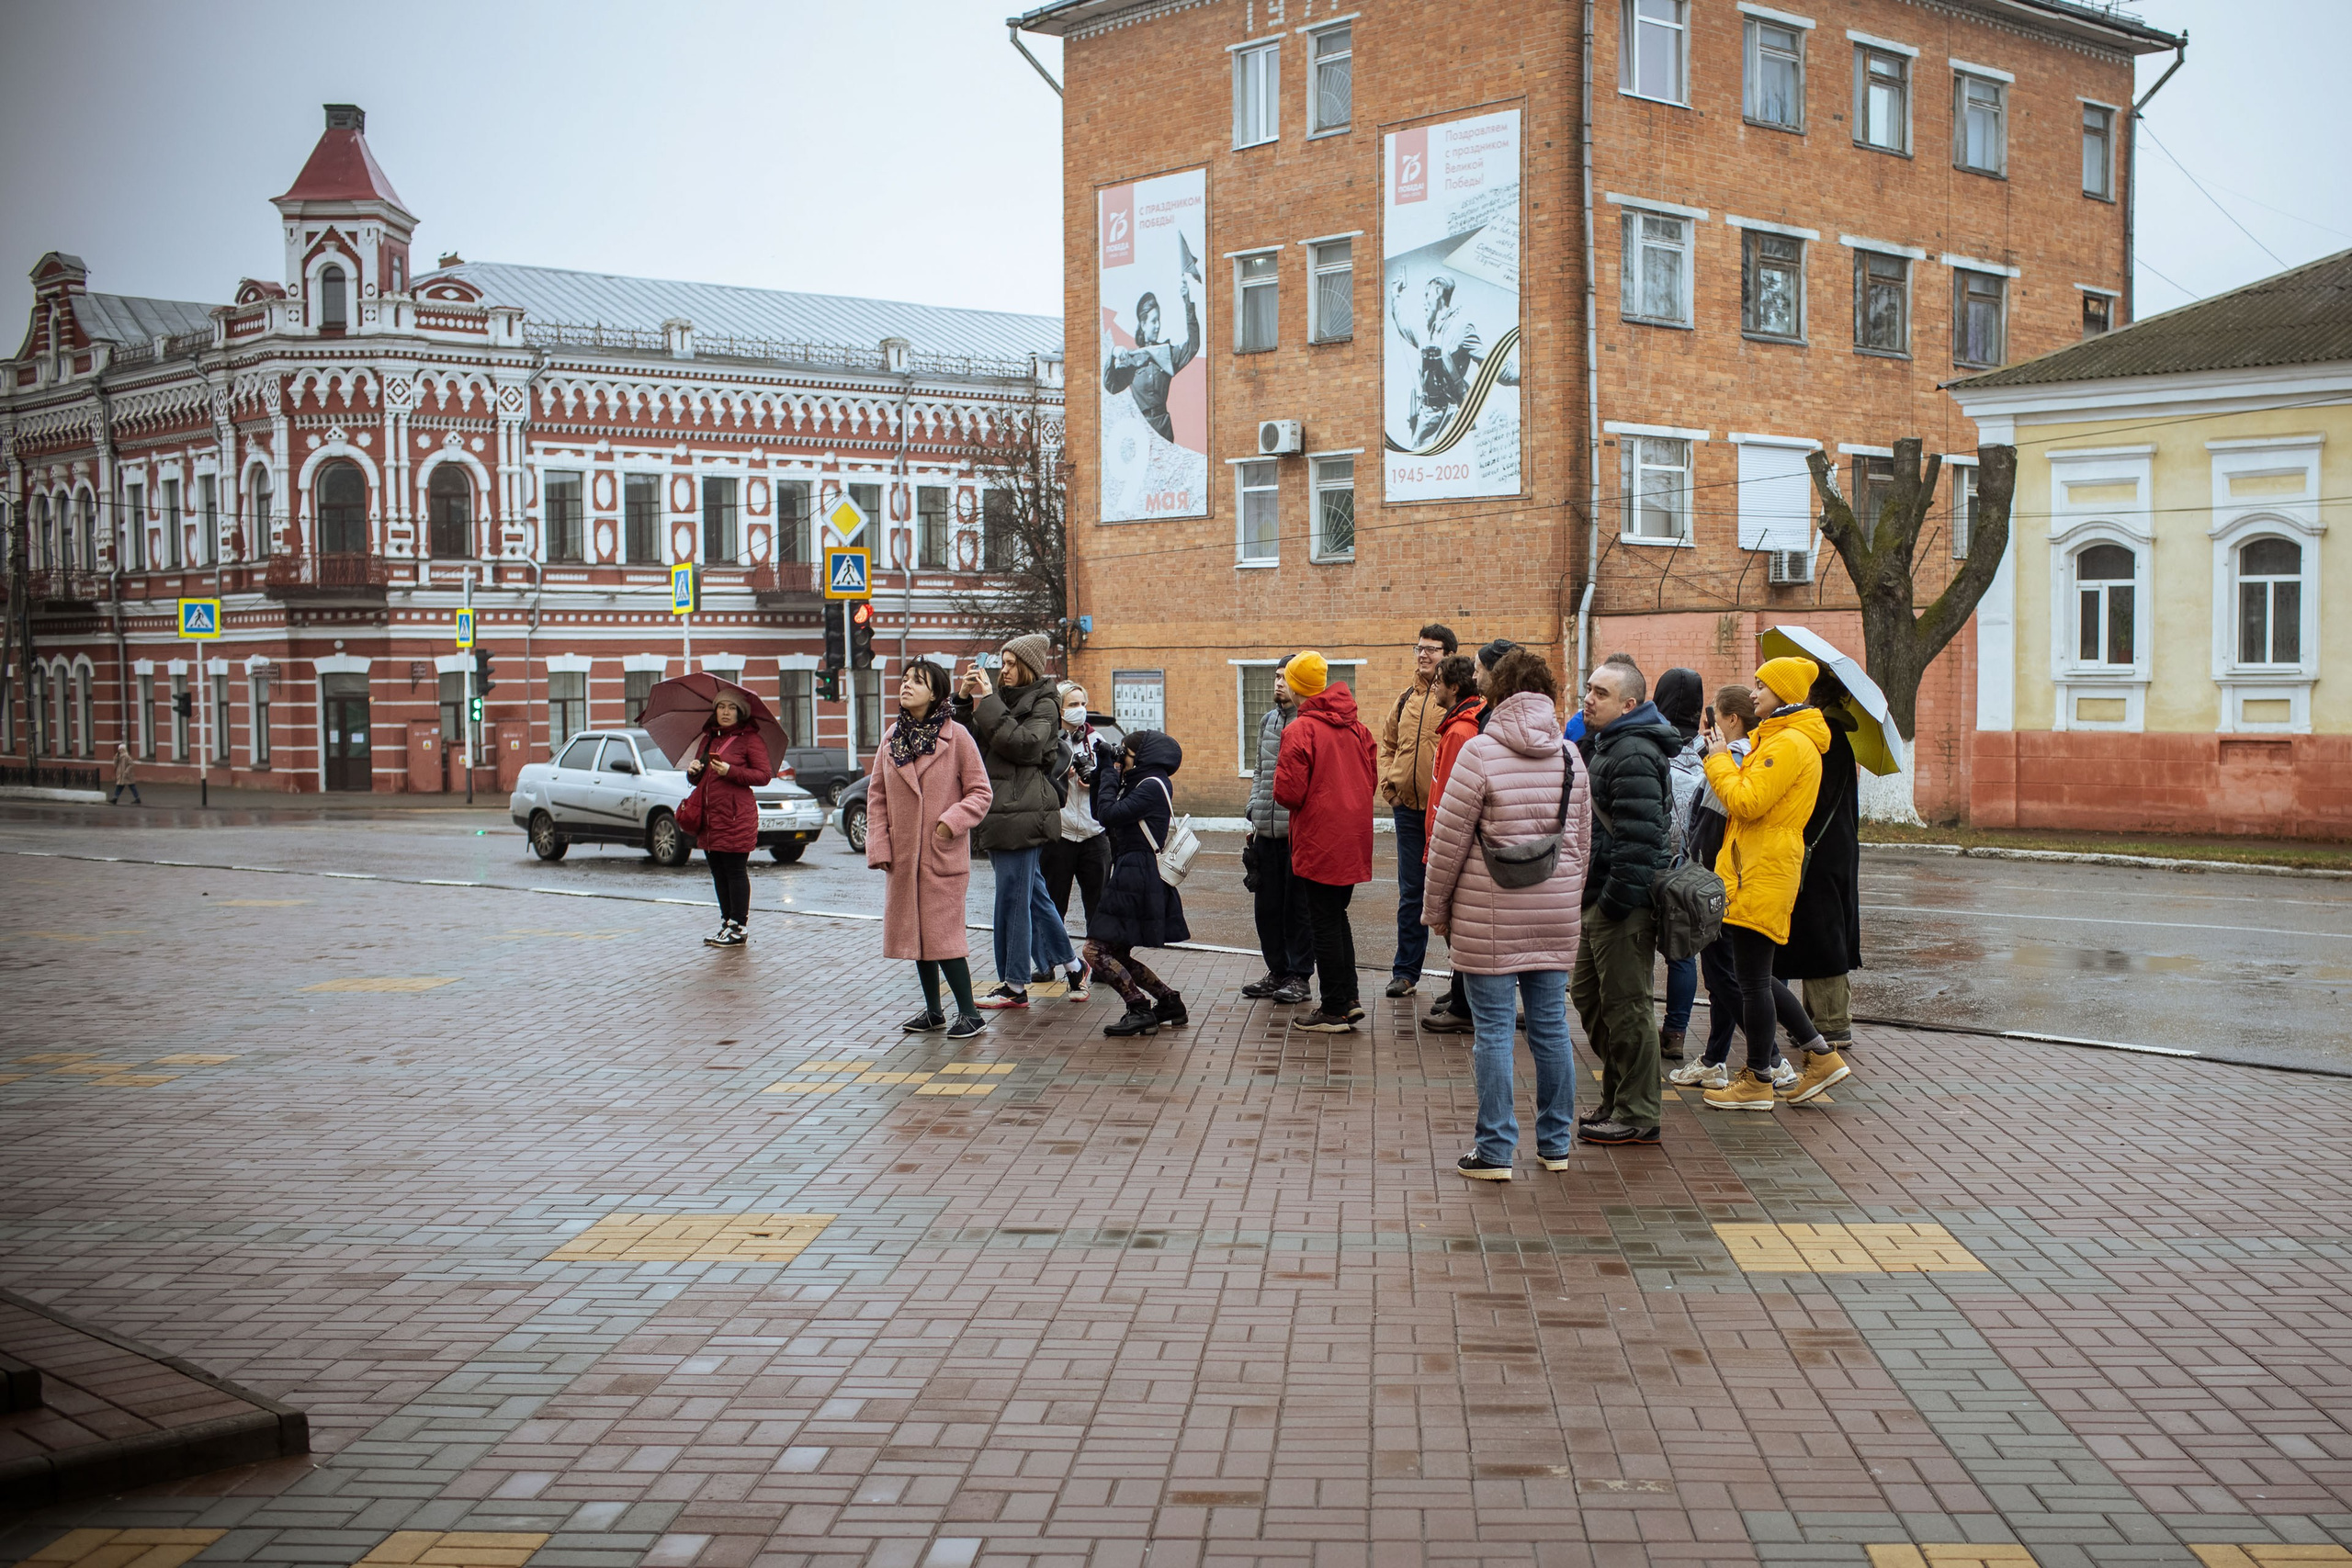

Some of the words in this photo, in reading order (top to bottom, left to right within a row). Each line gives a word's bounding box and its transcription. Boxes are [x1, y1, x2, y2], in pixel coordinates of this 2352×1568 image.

[1445, 123, 1508, 142] Поздравляем
[1453, 140, 1510, 159] праздником
[1445, 158, 1484, 174] Великой
[1445, 174, 1484, 190] Победы!
[1138, 206, 1145, 216] С
[1146, 196, 1202, 215] ПРАЗДНИКОМ
[1139, 215, 1175, 230] ПОБЕДЫ!
